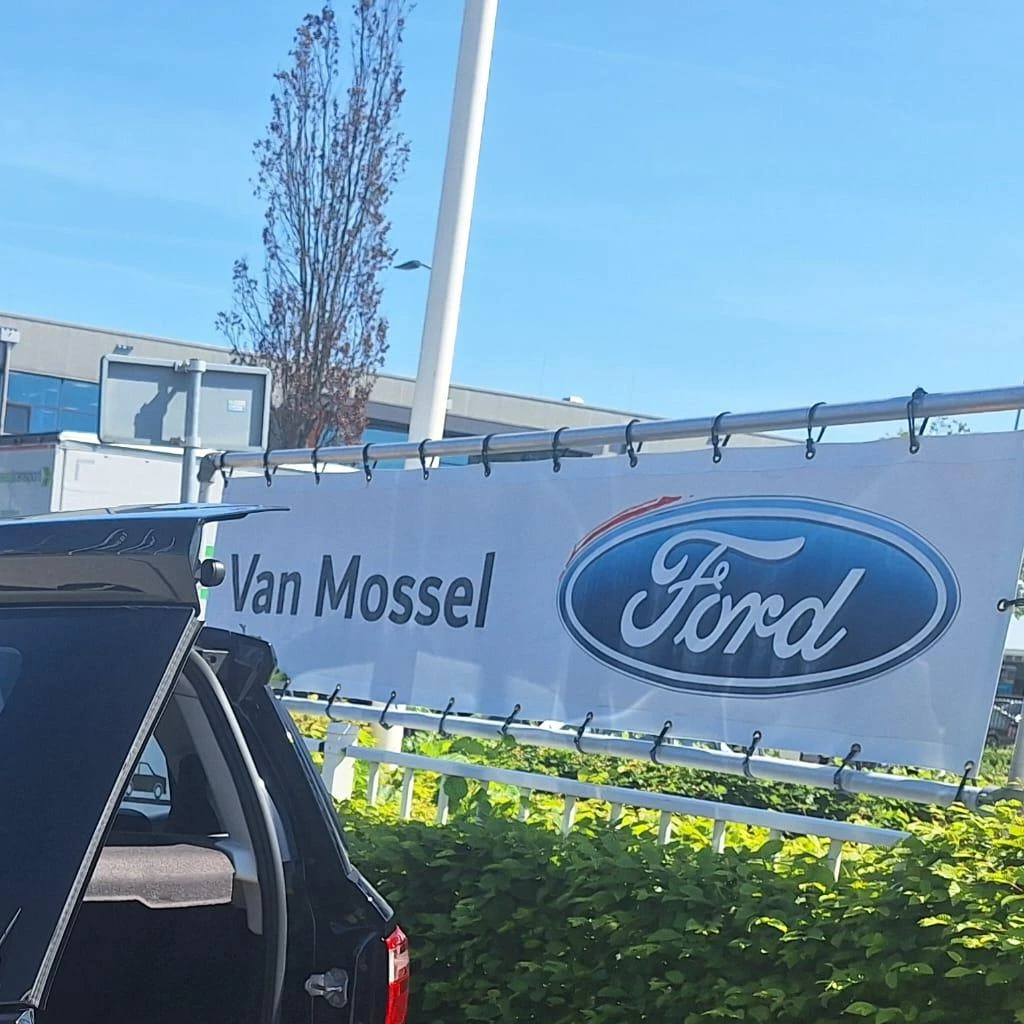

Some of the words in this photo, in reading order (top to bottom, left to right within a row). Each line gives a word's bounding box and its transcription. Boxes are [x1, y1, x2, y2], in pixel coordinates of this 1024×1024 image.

[231, 553, 302, 616] Van
[314, 551, 496, 629] Mossel
[620, 529, 866, 661] Ford
